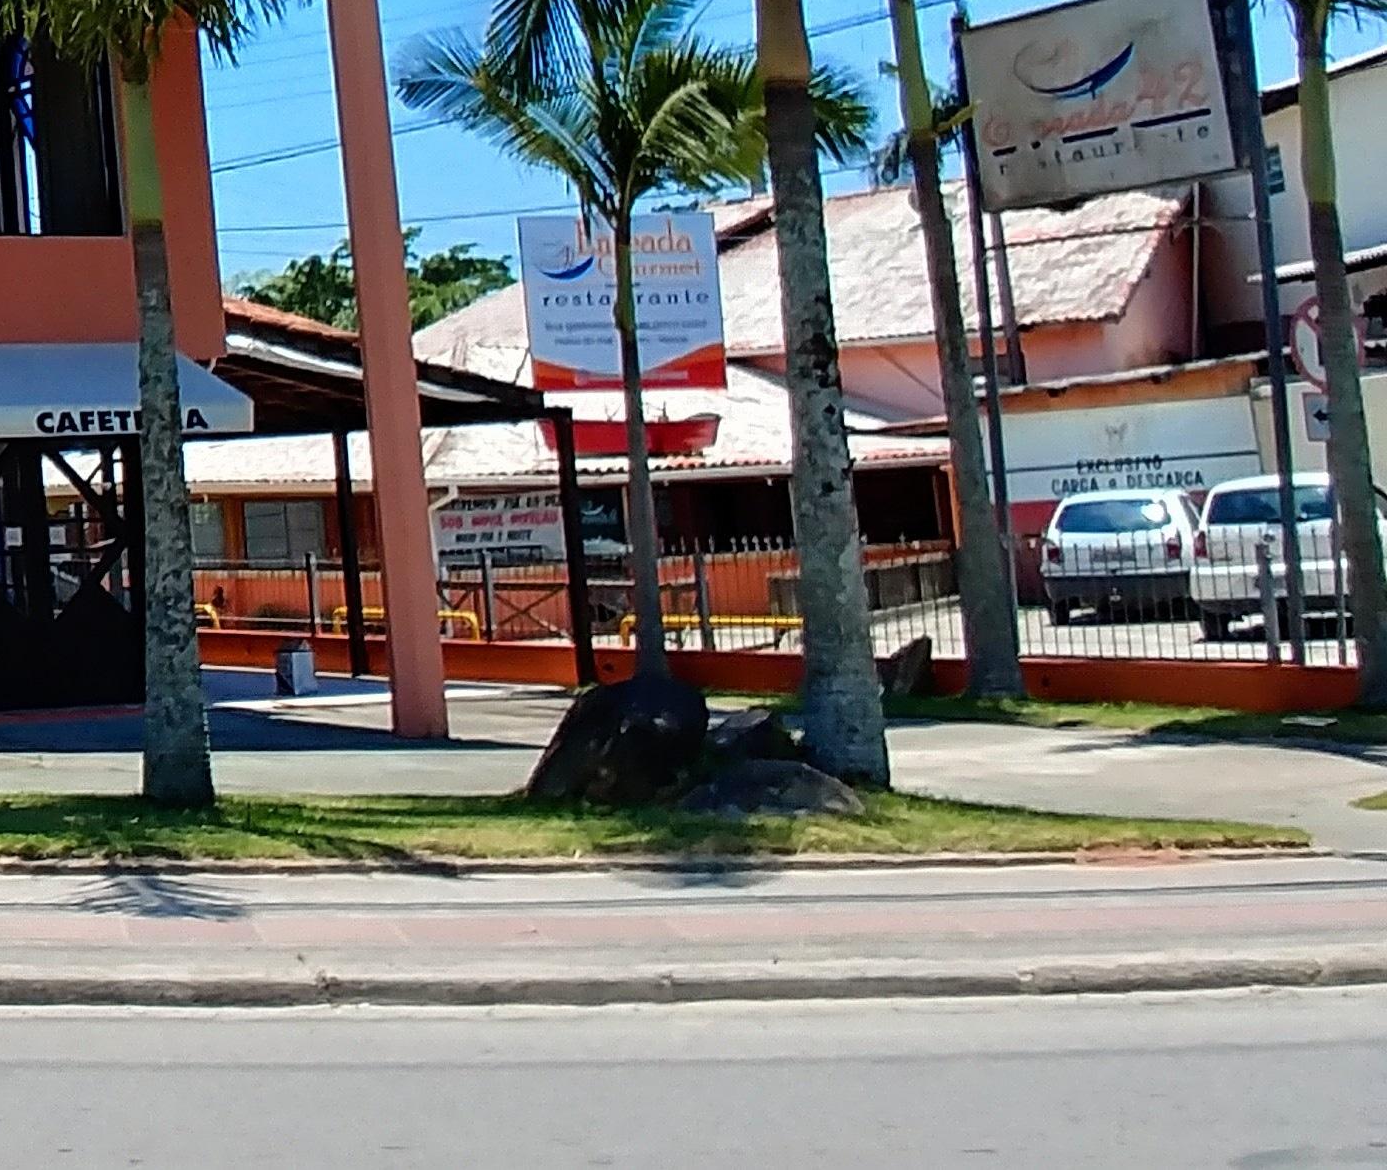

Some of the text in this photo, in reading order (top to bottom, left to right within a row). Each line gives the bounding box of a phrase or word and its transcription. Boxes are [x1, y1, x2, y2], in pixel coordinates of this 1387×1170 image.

[542, 289, 710, 307] restarante
[36, 408, 209, 434] CAFETA
[1126, 469, 1205, 490] DESCARGA
